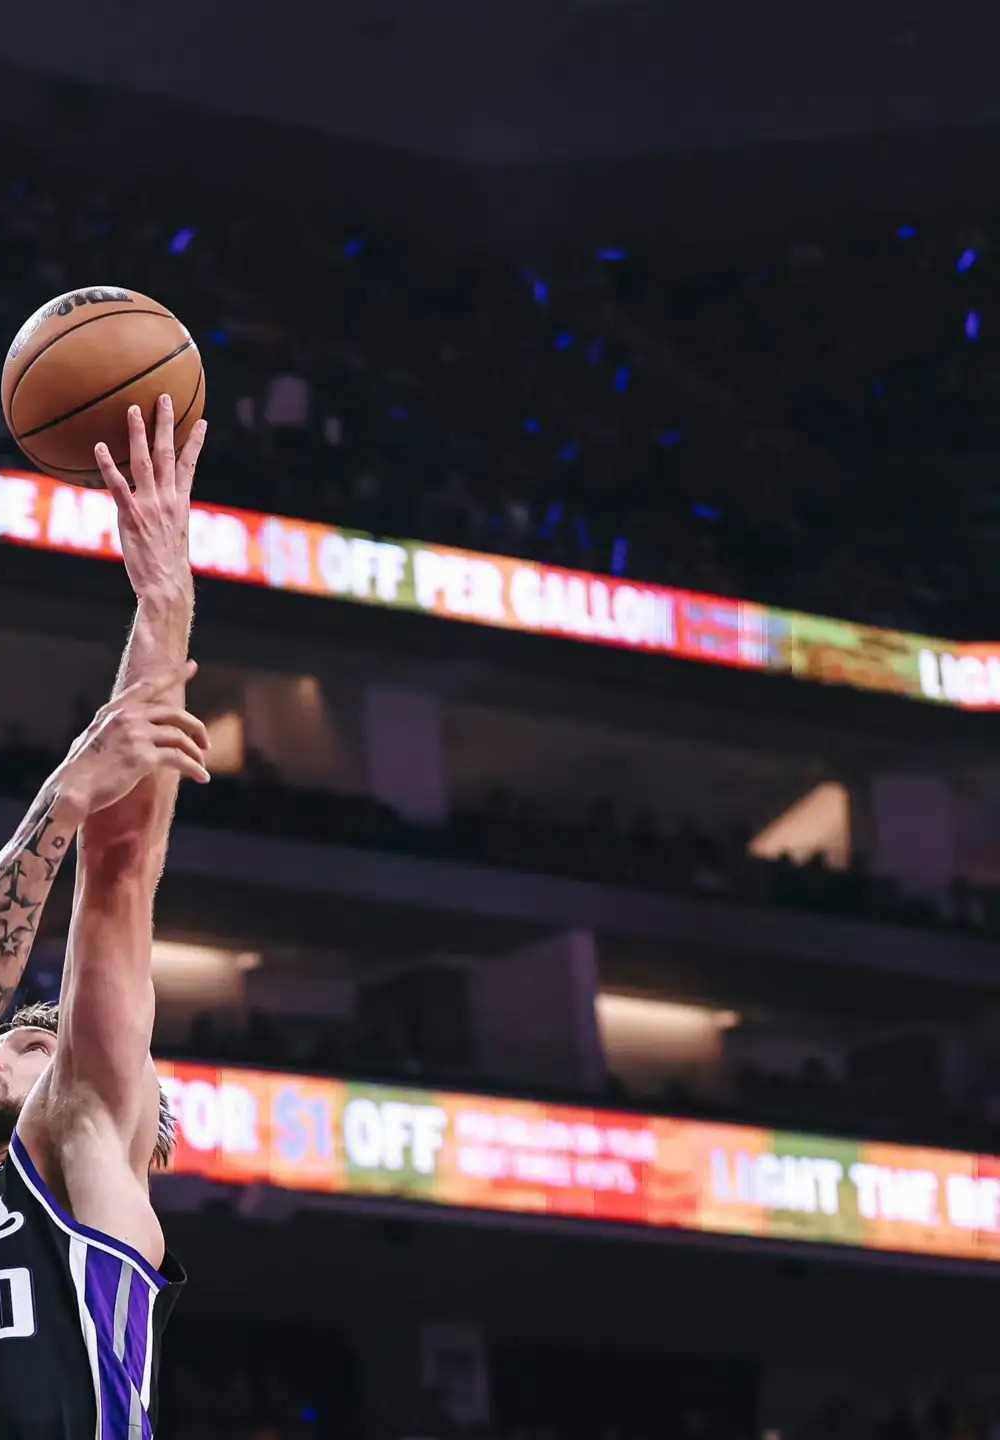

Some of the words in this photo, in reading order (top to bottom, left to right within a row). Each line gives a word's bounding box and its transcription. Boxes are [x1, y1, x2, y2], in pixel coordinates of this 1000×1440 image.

[318, 531, 408, 601] OFF
[413, 549, 503, 621] PER
[509, 568, 677, 649] GALLON
[273, 1084, 333, 1163] $1
[342, 1097, 449, 1175] OFF
[709, 1145, 844, 1217] LIGHT
[848, 1161, 939, 1226] THE
